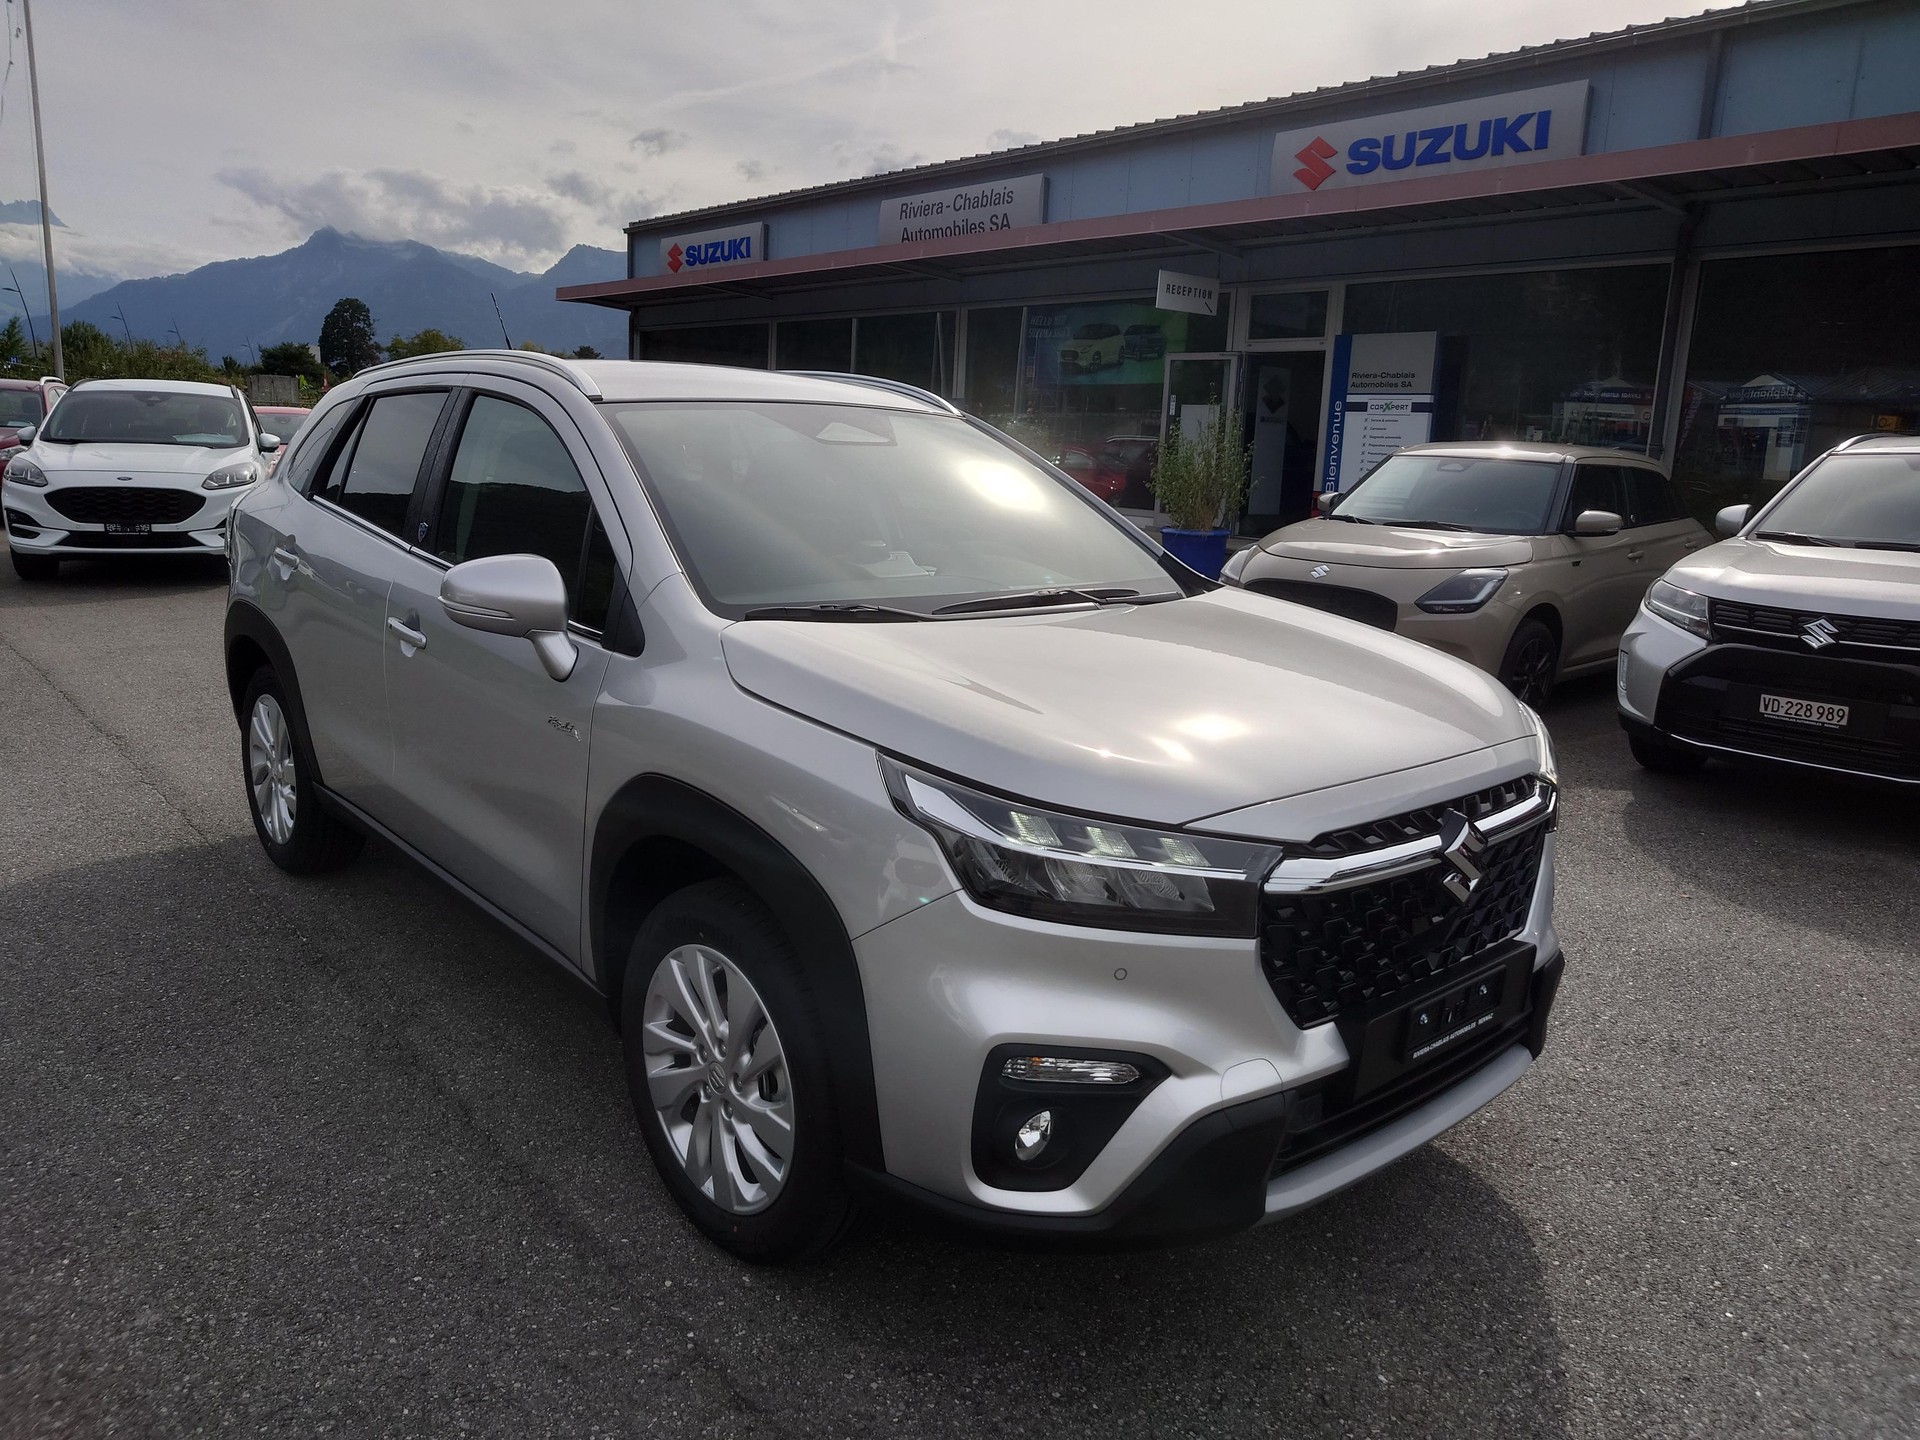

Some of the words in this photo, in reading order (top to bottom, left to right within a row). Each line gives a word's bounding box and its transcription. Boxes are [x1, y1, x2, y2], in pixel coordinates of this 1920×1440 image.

[1345, 109, 1553, 175] SUZUKI
[901, 218, 985, 243] Automobiles
[989, 212, 1011, 232] SA
[685, 236, 752, 267] SUZUKI
[1165, 283, 1213, 300] RECEPTION
[1351, 371, 1416, 379] Riviera-Chablais
[1325, 400, 1343, 493] Bienvenue
